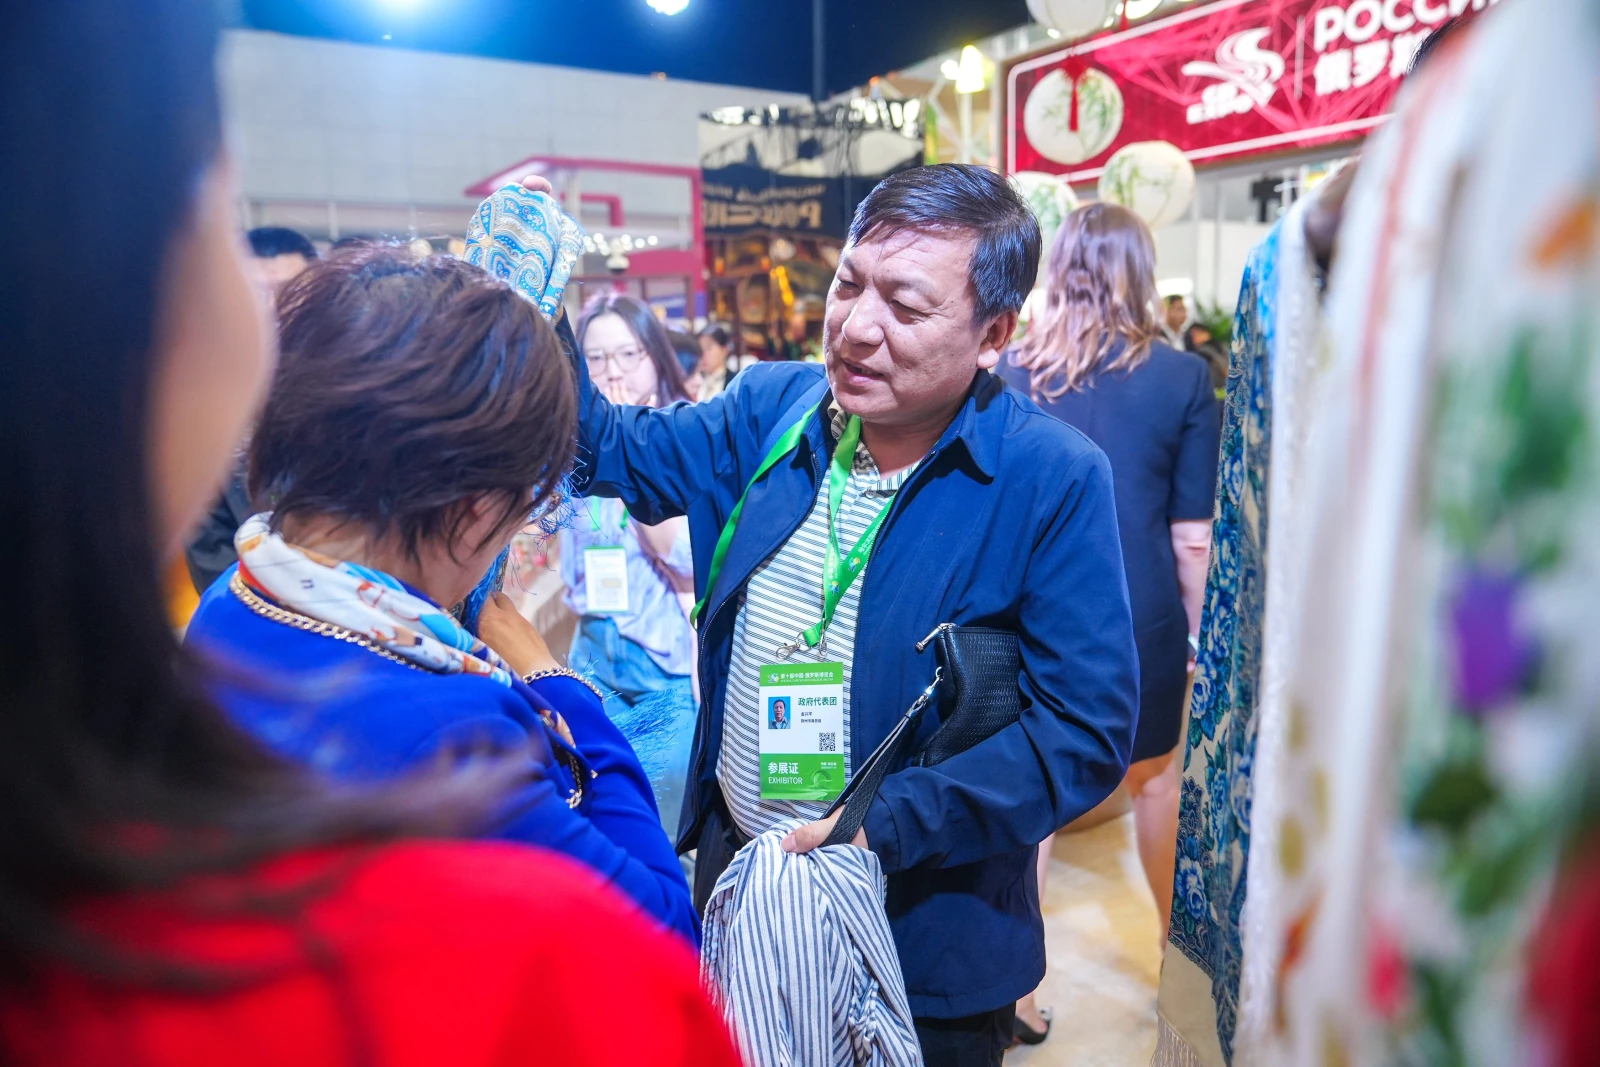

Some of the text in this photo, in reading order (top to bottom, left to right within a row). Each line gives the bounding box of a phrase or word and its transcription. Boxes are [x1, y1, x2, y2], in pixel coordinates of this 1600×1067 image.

[798, 696, 837, 706] 政府代表团
[768, 762, 799, 774] 参展证
[768, 776, 803, 785] EXHIBITOR
